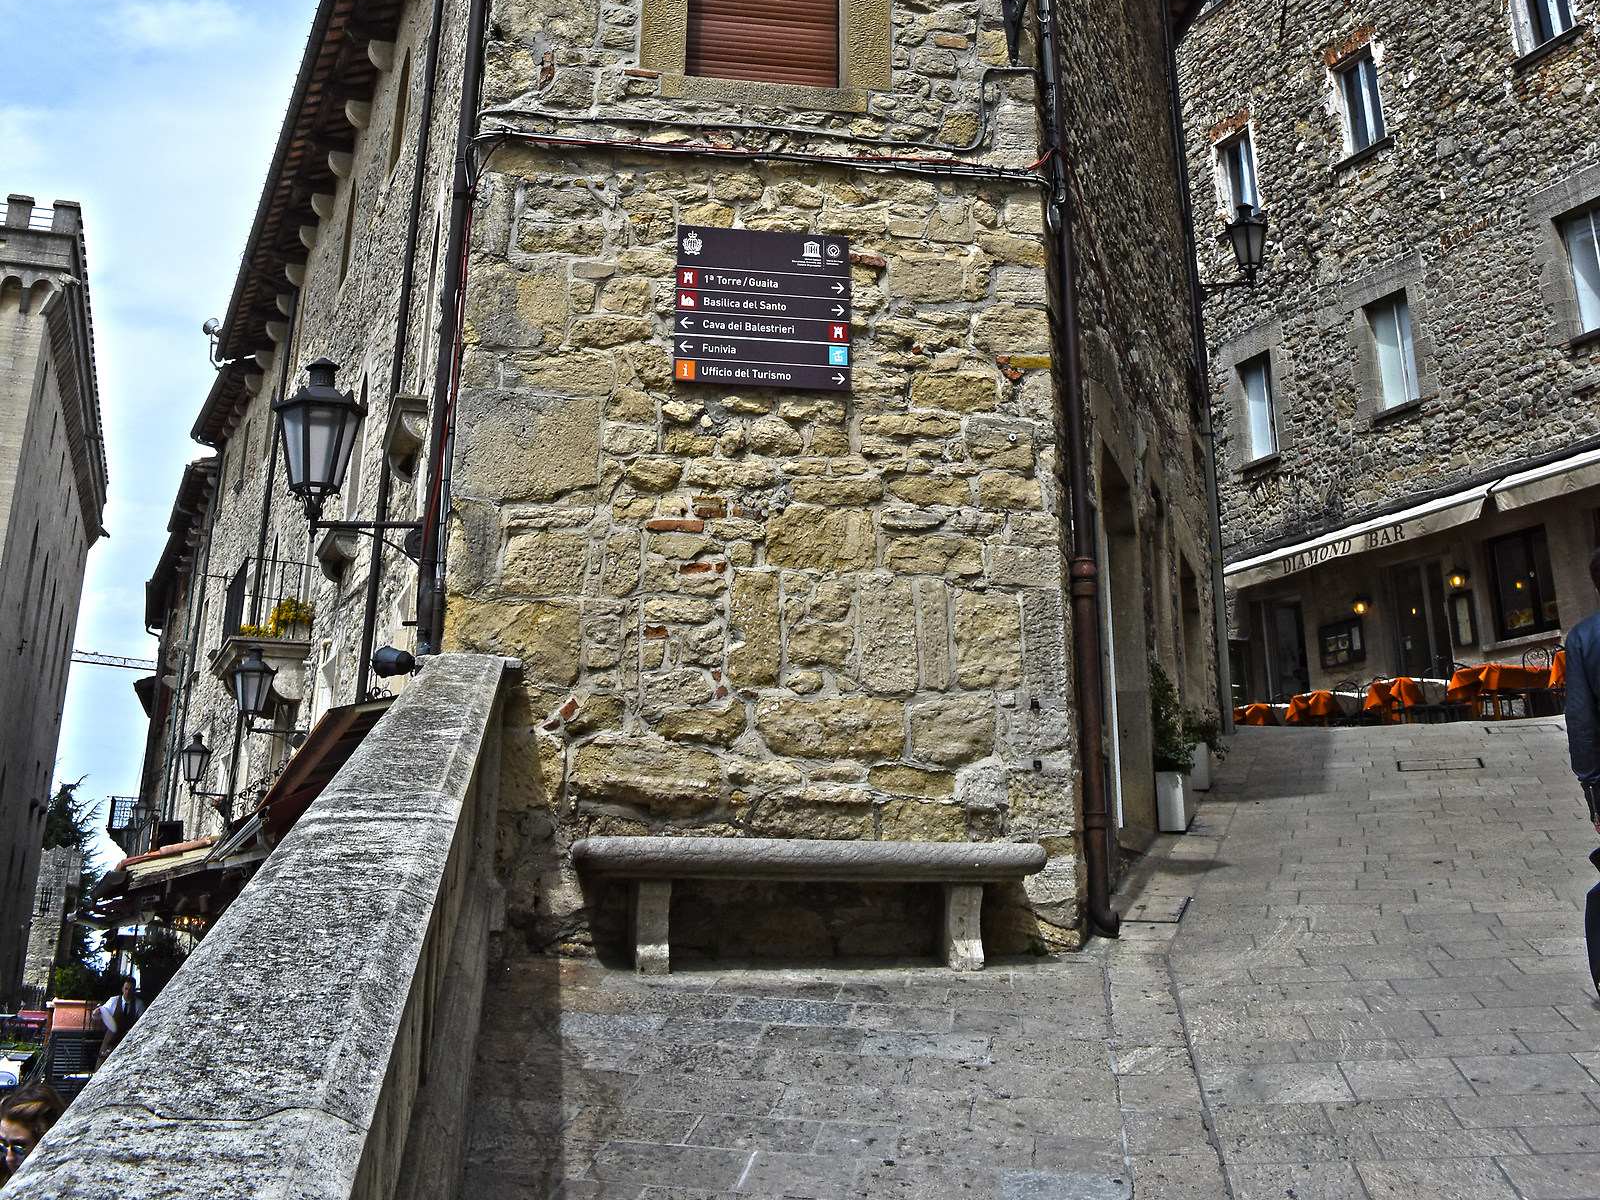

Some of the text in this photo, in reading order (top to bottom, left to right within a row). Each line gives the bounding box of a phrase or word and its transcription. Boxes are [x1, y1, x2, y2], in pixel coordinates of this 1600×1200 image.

[703, 296, 787, 311] Basilica del Santo
[702, 319, 795, 334] Cava dei Balestrieri
[702, 343, 737, 354] Funivia
[702, 366, 792, 381] Ufficio del Turismo
[1282, 524, 1406, 575] DIAMOND BAR
